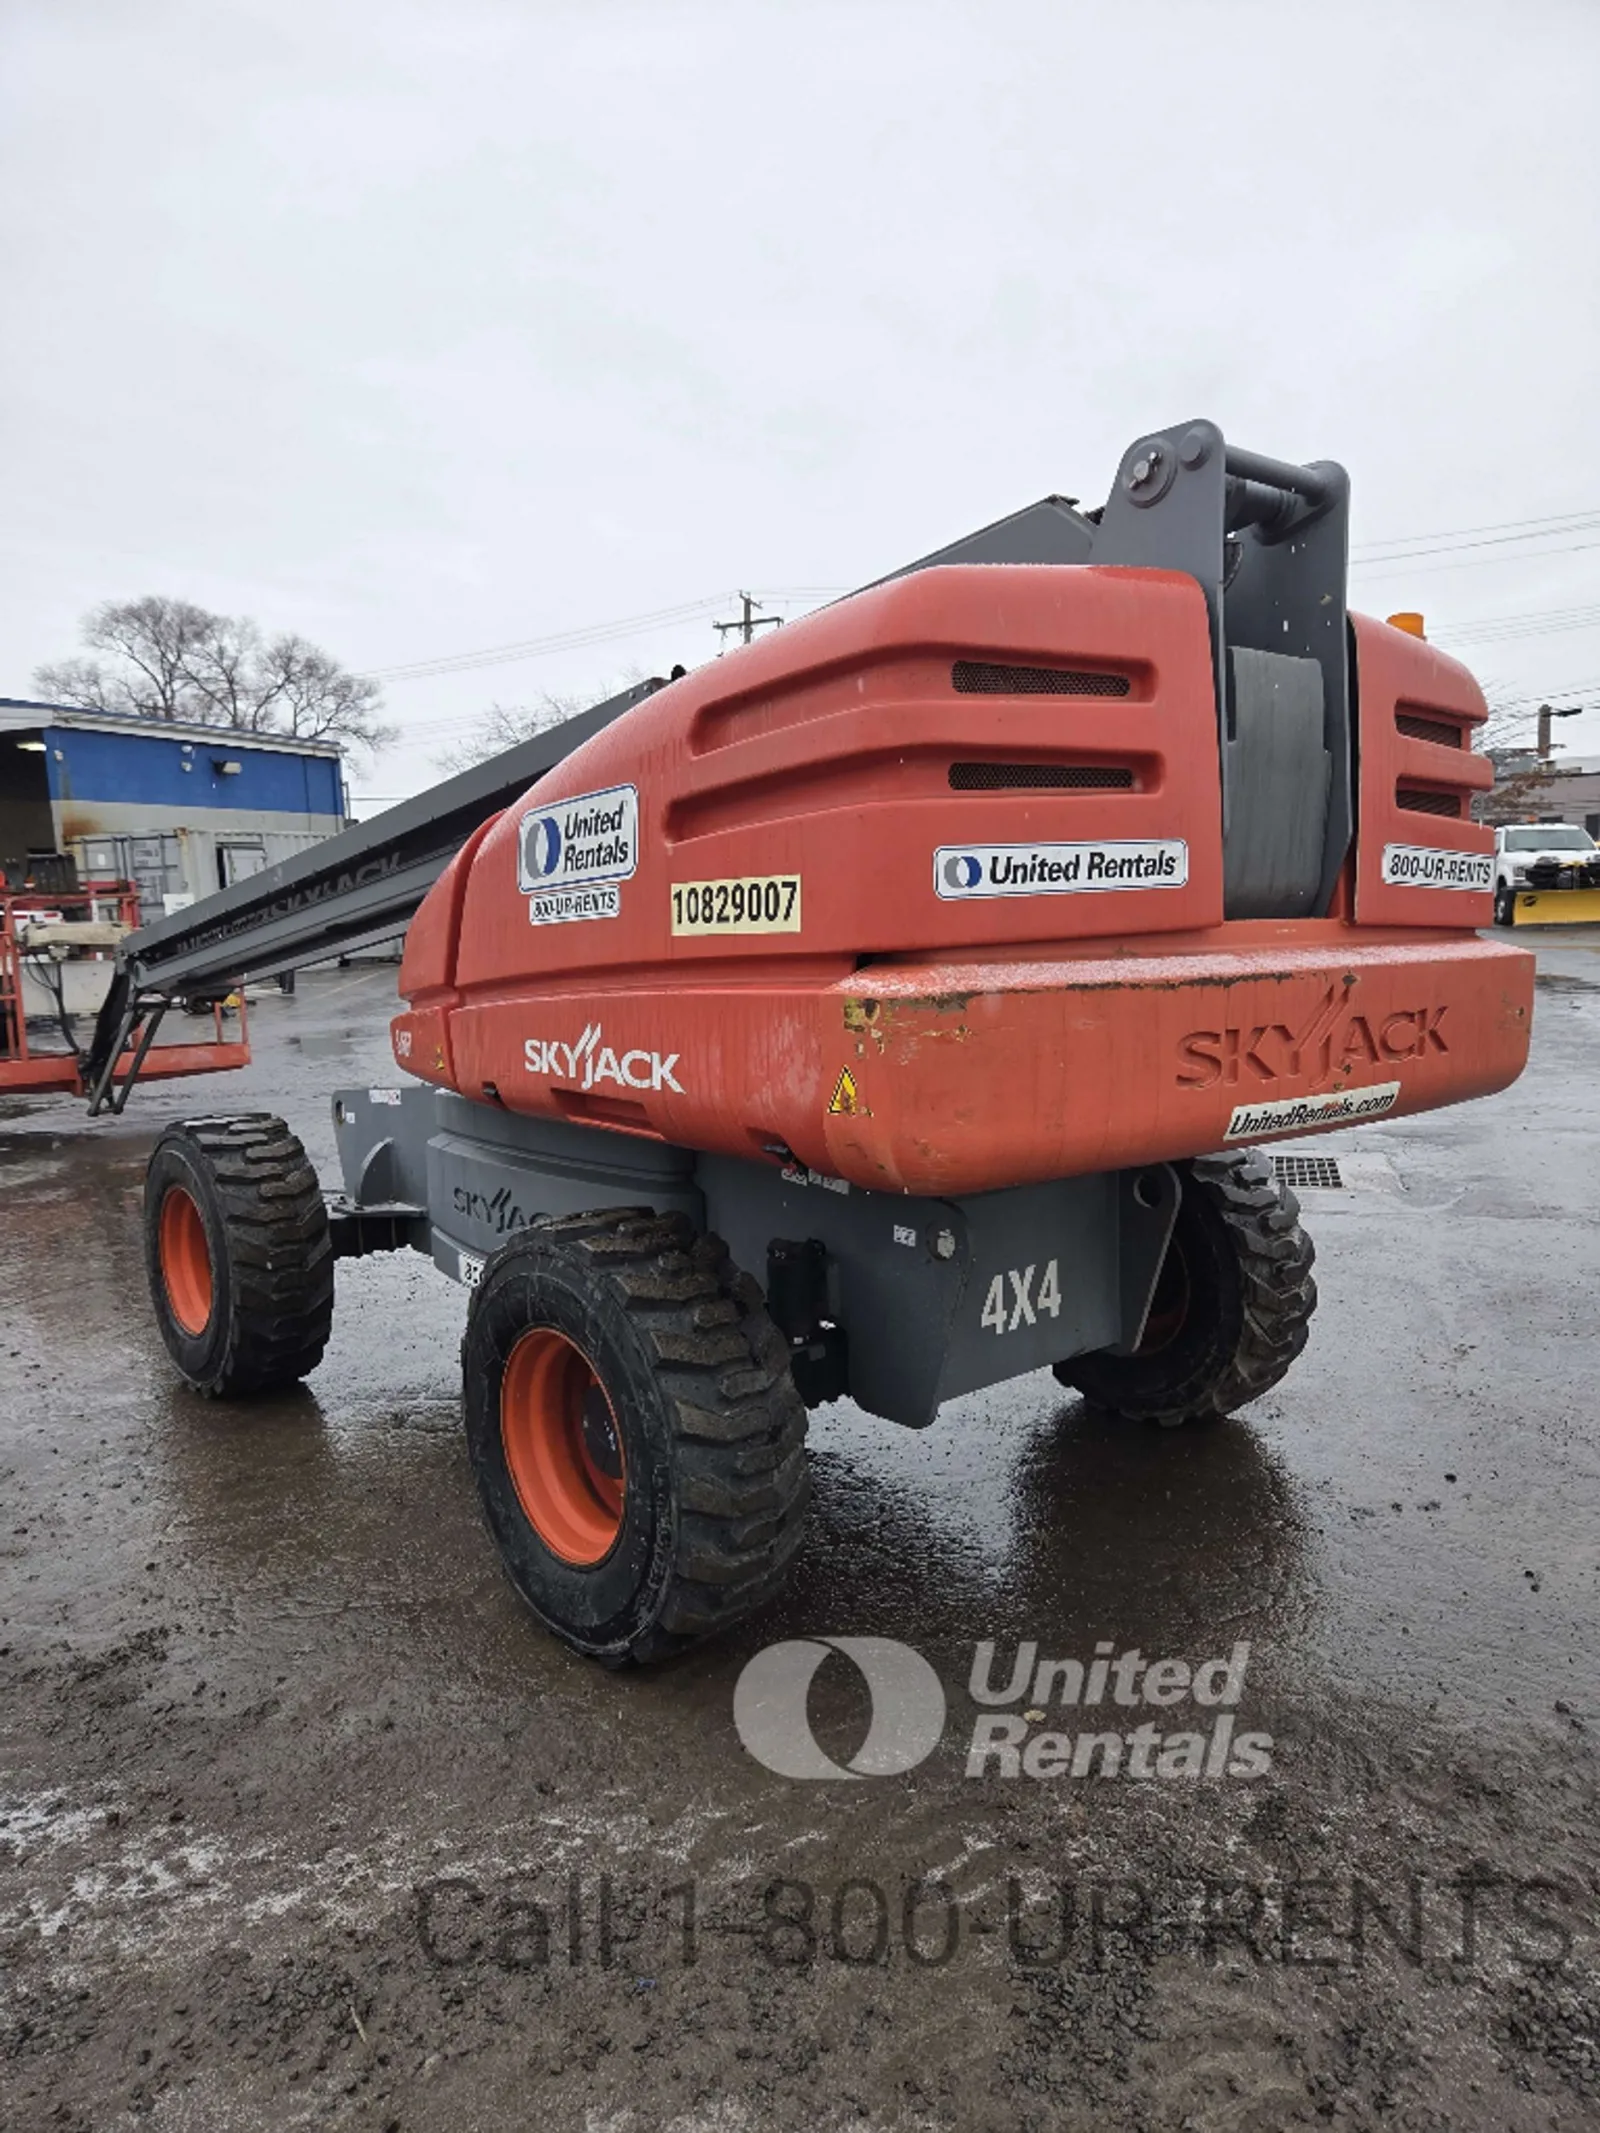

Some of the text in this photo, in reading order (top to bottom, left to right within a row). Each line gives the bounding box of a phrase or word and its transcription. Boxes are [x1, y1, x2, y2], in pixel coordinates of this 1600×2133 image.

[565, 801, 624, 840] United
[563, 839, 629, 873] Rentals
[990, 850, 1177, 884] United Rentals
[1390, 854, 1491, 884] 800-UR-RENTS
[673, 881, 798, 924] 10829007
[1175, 984, 1450, 1089] SKYJACK
[524, 1023, 686, 1094] SKYJACK
[453, 1187, 554, 1234] SKYJA
[981, 1259, 1061, 1335] 4X4
